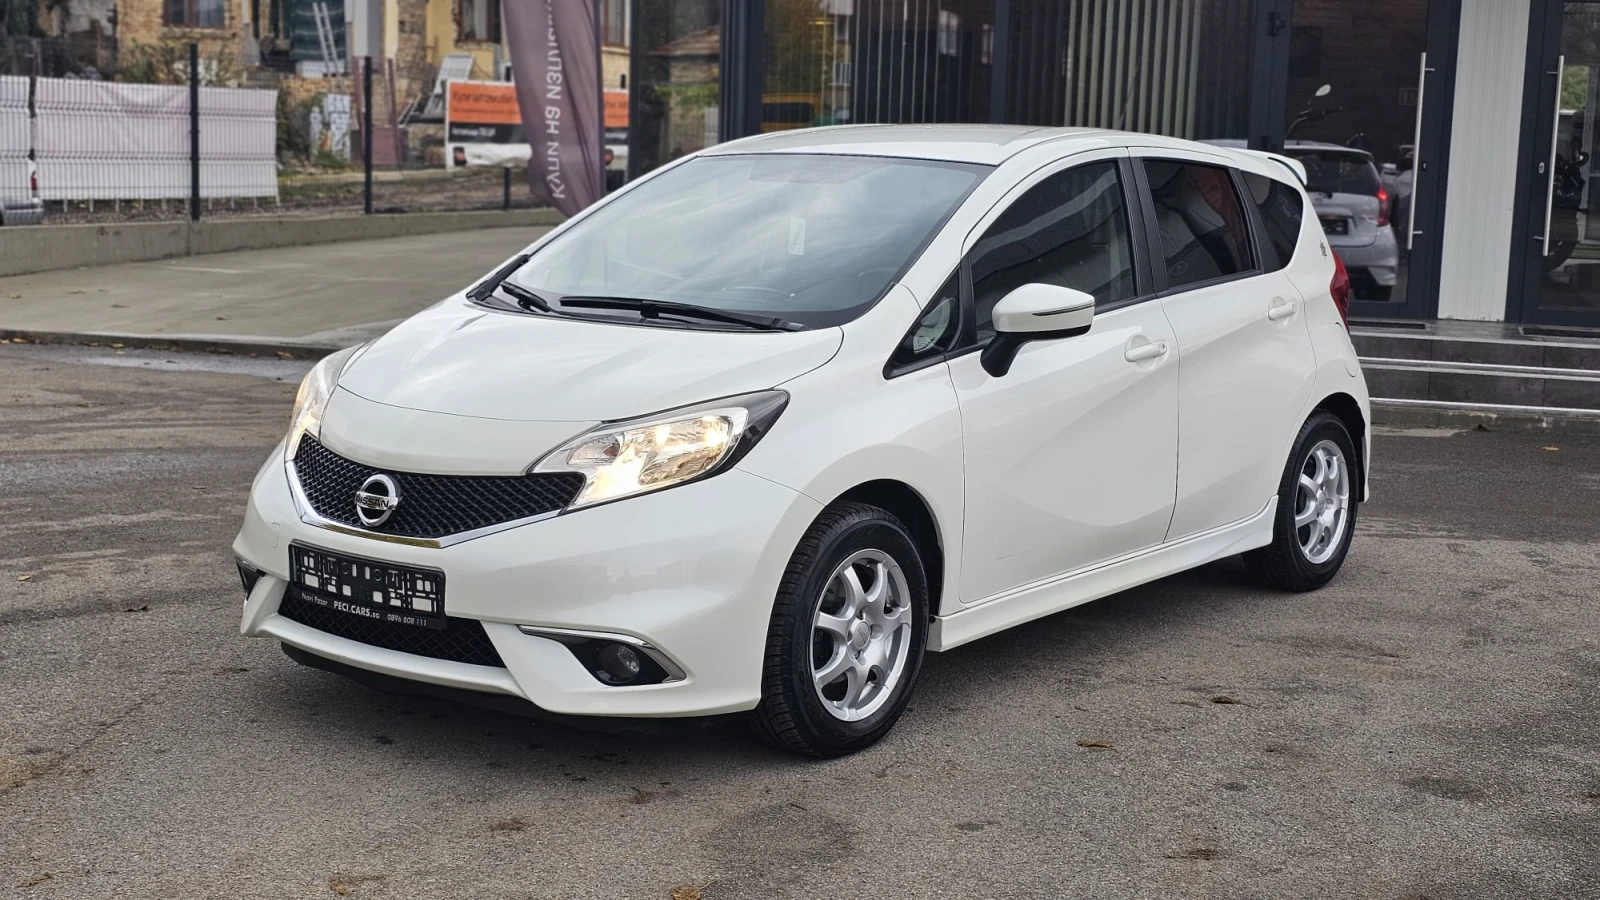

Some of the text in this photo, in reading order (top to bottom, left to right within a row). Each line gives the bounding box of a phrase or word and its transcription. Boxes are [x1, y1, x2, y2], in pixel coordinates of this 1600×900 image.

[355, 493, 389, 508] NISSAN
[387, 613, 402, 623] 0896
[403, 616, 415, 625] 808
